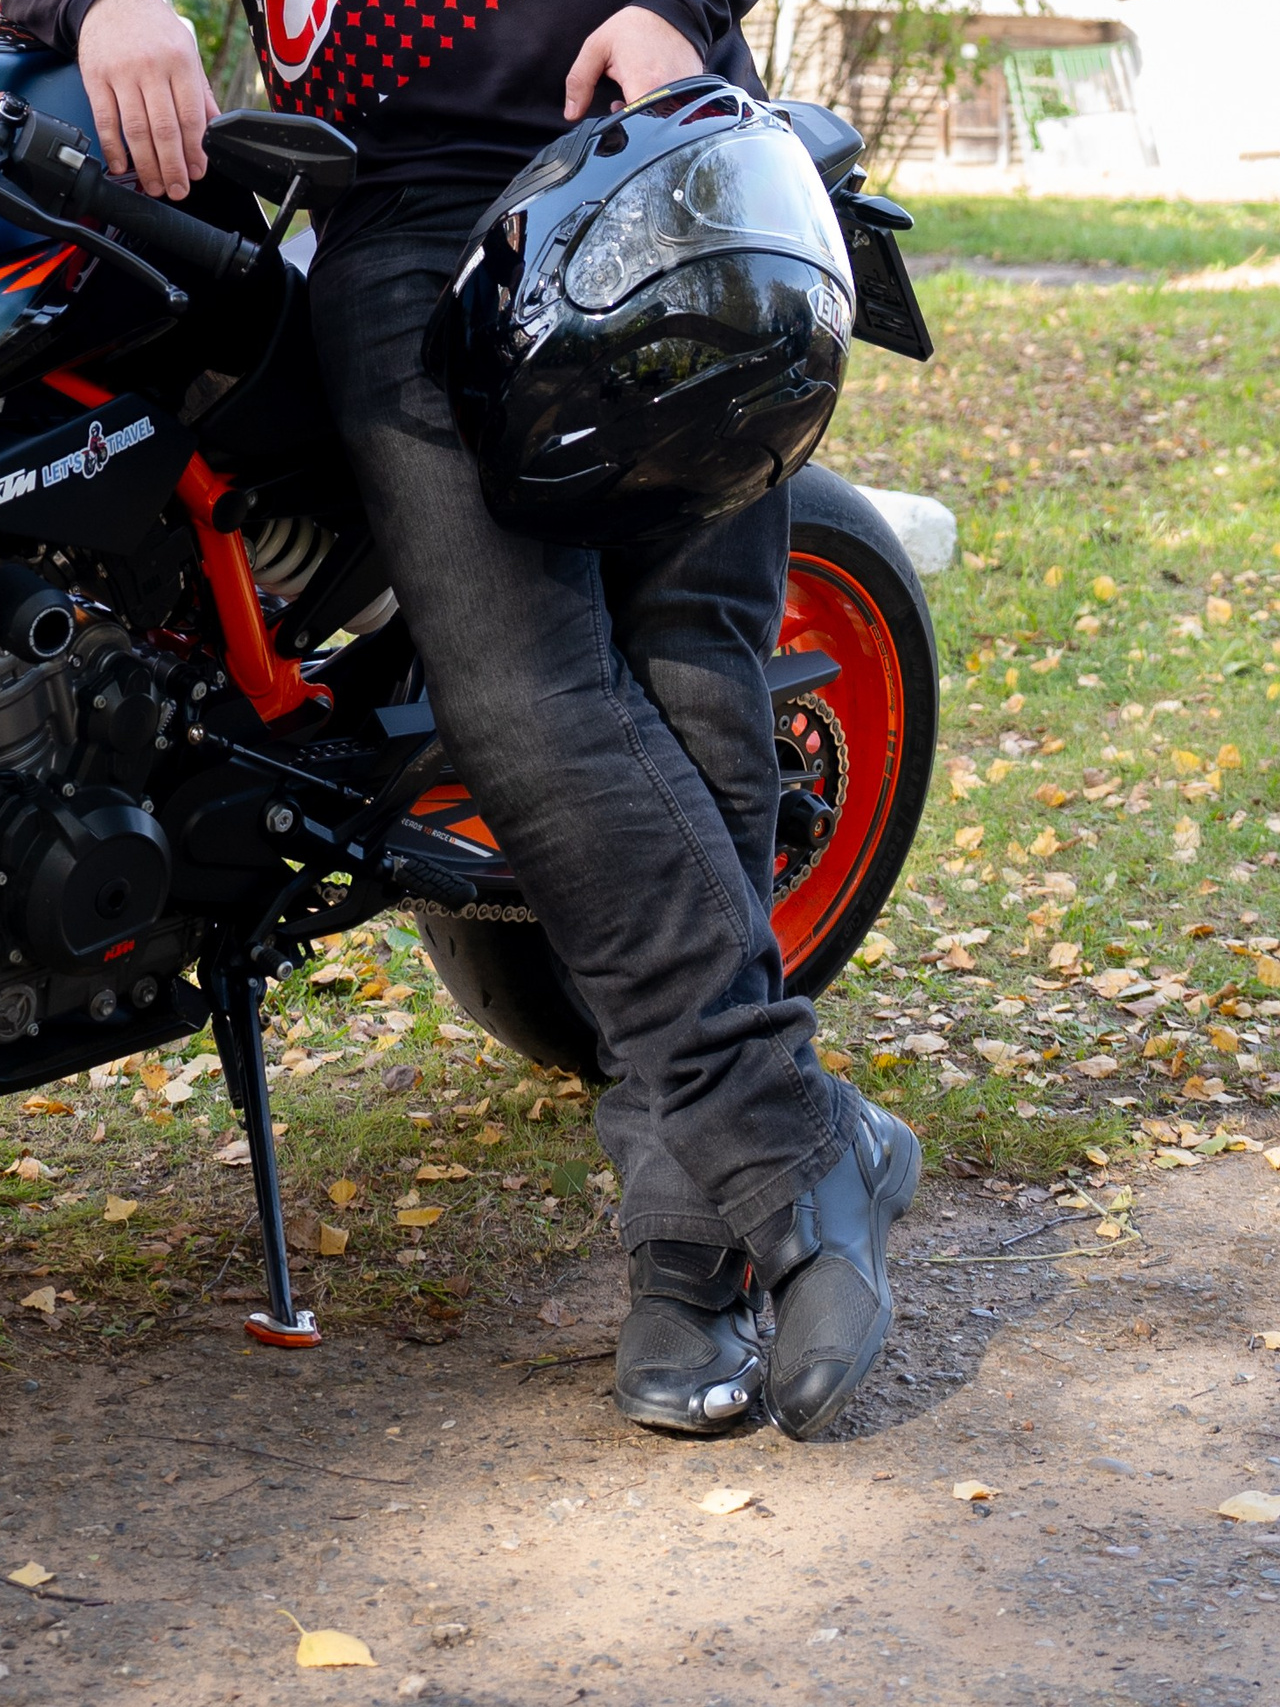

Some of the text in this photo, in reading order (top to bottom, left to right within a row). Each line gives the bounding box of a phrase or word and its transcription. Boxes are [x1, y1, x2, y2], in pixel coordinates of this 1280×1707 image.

[817, 289, 851, 351] HOEI
[41, 415, 156, 488] LET'S TRAVEL
[431, 830, 450, 842] RACE
